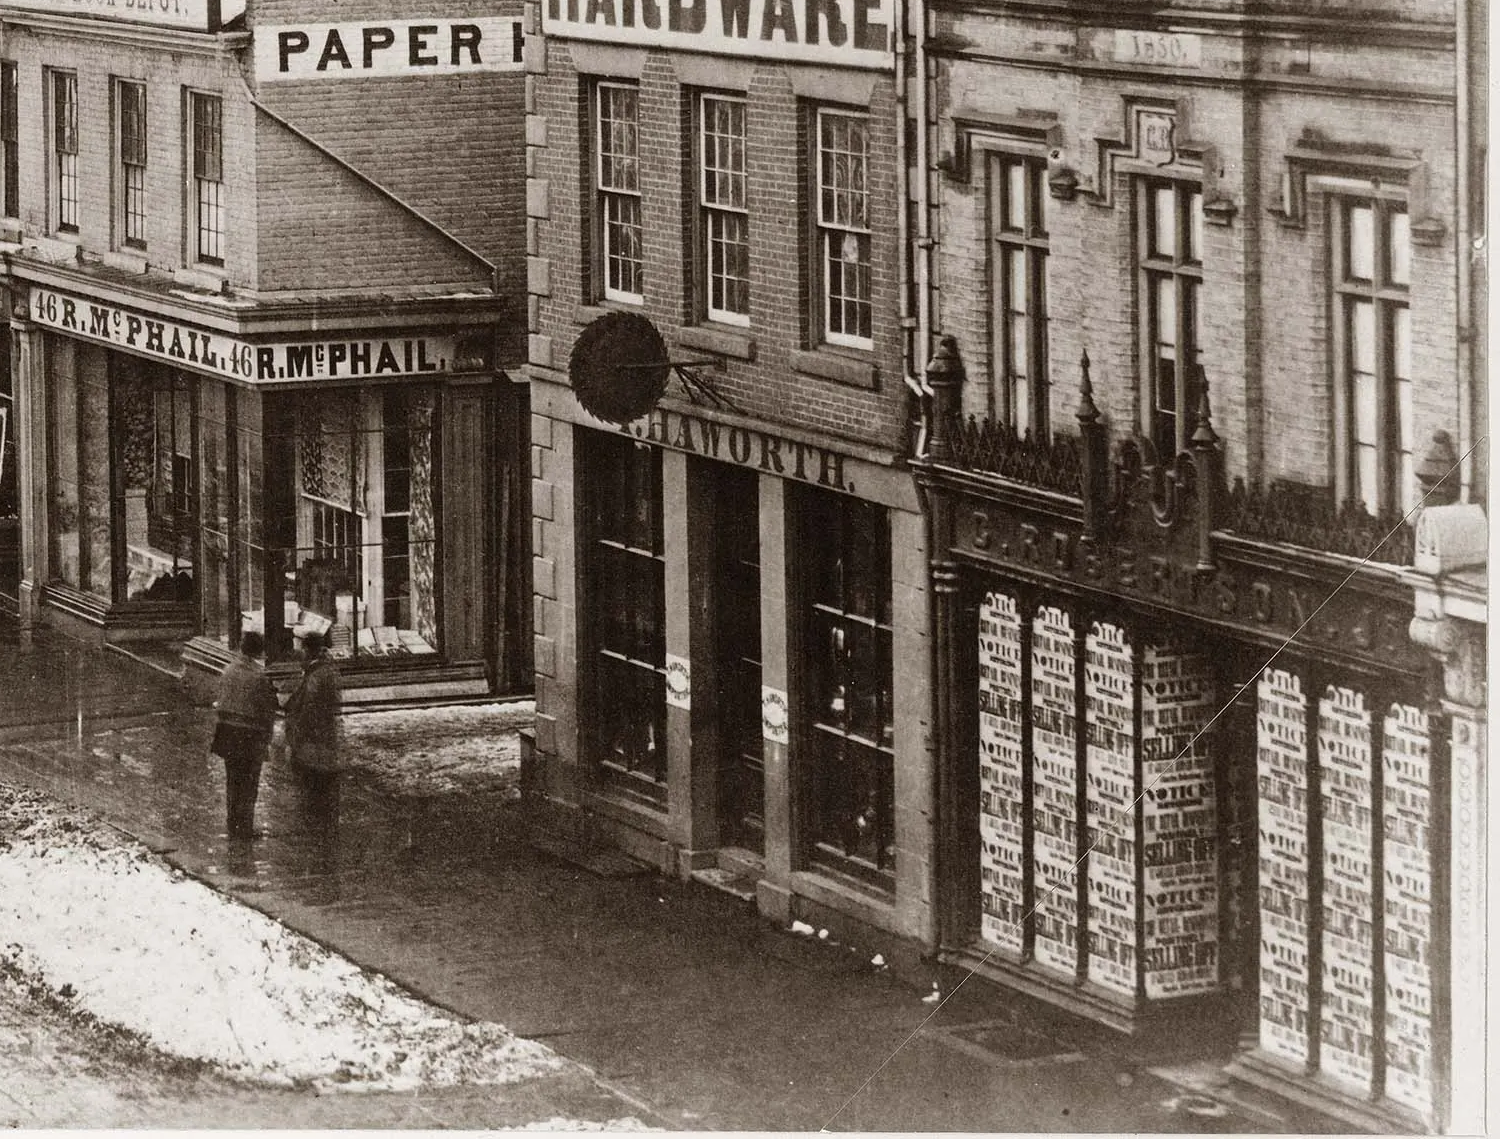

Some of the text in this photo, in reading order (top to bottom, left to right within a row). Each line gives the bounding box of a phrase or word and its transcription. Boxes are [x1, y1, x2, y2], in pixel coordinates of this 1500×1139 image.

[278, 24, 482, 72] PAPER
[35, 291, 57, 322] 46
[229, 342, 253, 377] 46
